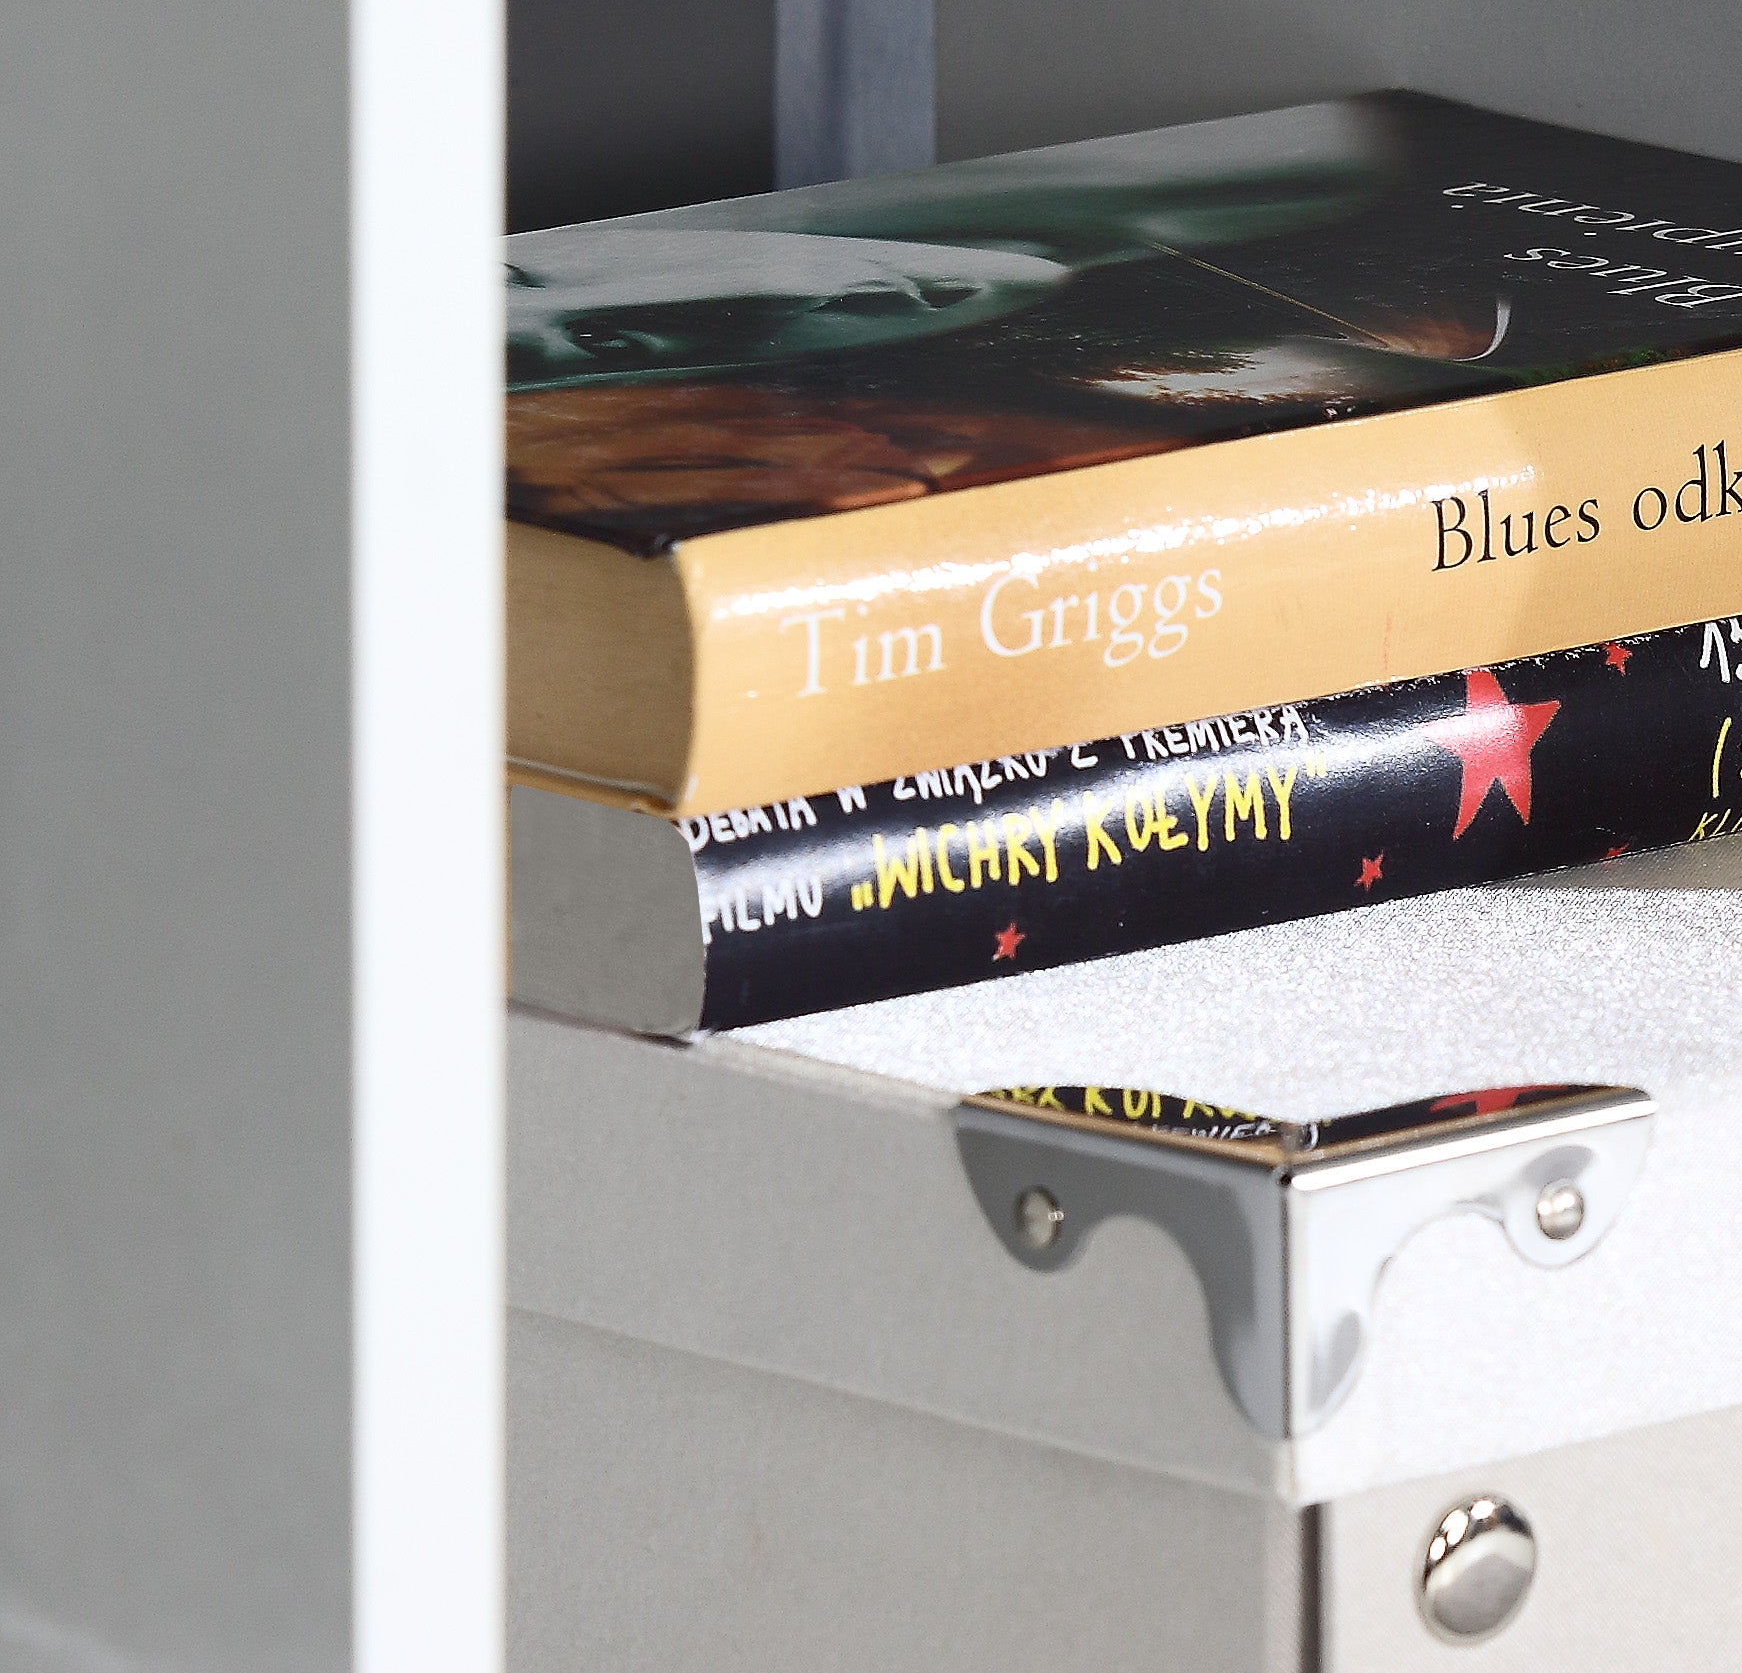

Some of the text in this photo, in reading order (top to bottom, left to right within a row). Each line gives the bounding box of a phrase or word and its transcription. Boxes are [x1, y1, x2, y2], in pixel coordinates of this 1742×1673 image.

[1431, 488, 1601, 572] Blues
[781, 560, 1223, 698] Tim Griggs
